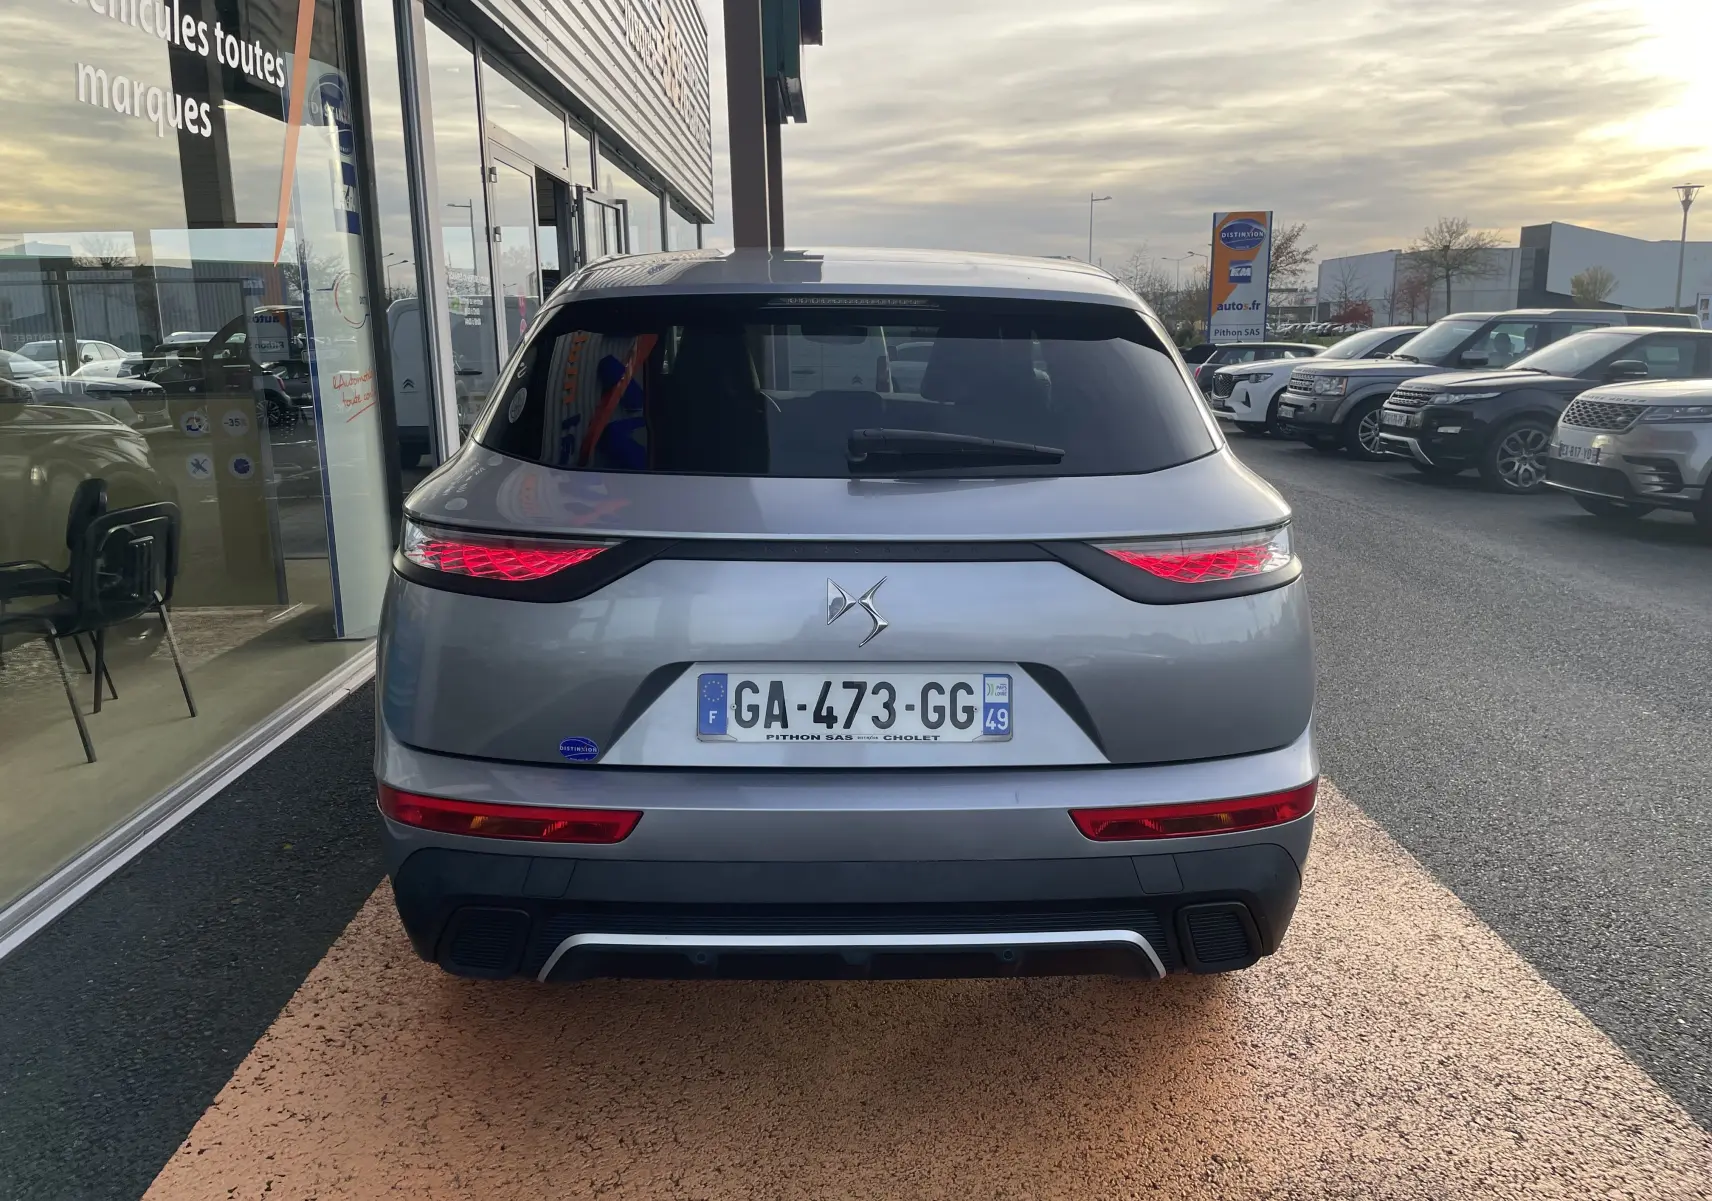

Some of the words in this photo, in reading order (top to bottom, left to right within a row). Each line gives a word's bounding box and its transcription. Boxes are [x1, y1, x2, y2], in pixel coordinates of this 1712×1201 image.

[215, 22, 285, 87] toutes
[78, 62, 212, 137] marques
[1216, 300, 1261, 311] autos.fr
[1214, 329, 1242, 337] Pithon
[1244, 328, 1260, 336] SAS
[734, 680, 975, 729] GA-473-GG
[985, 708, 1009, 730] 49
[708, 710, 718, 724] F
[560, 745, 598, 753] DISTINXION
